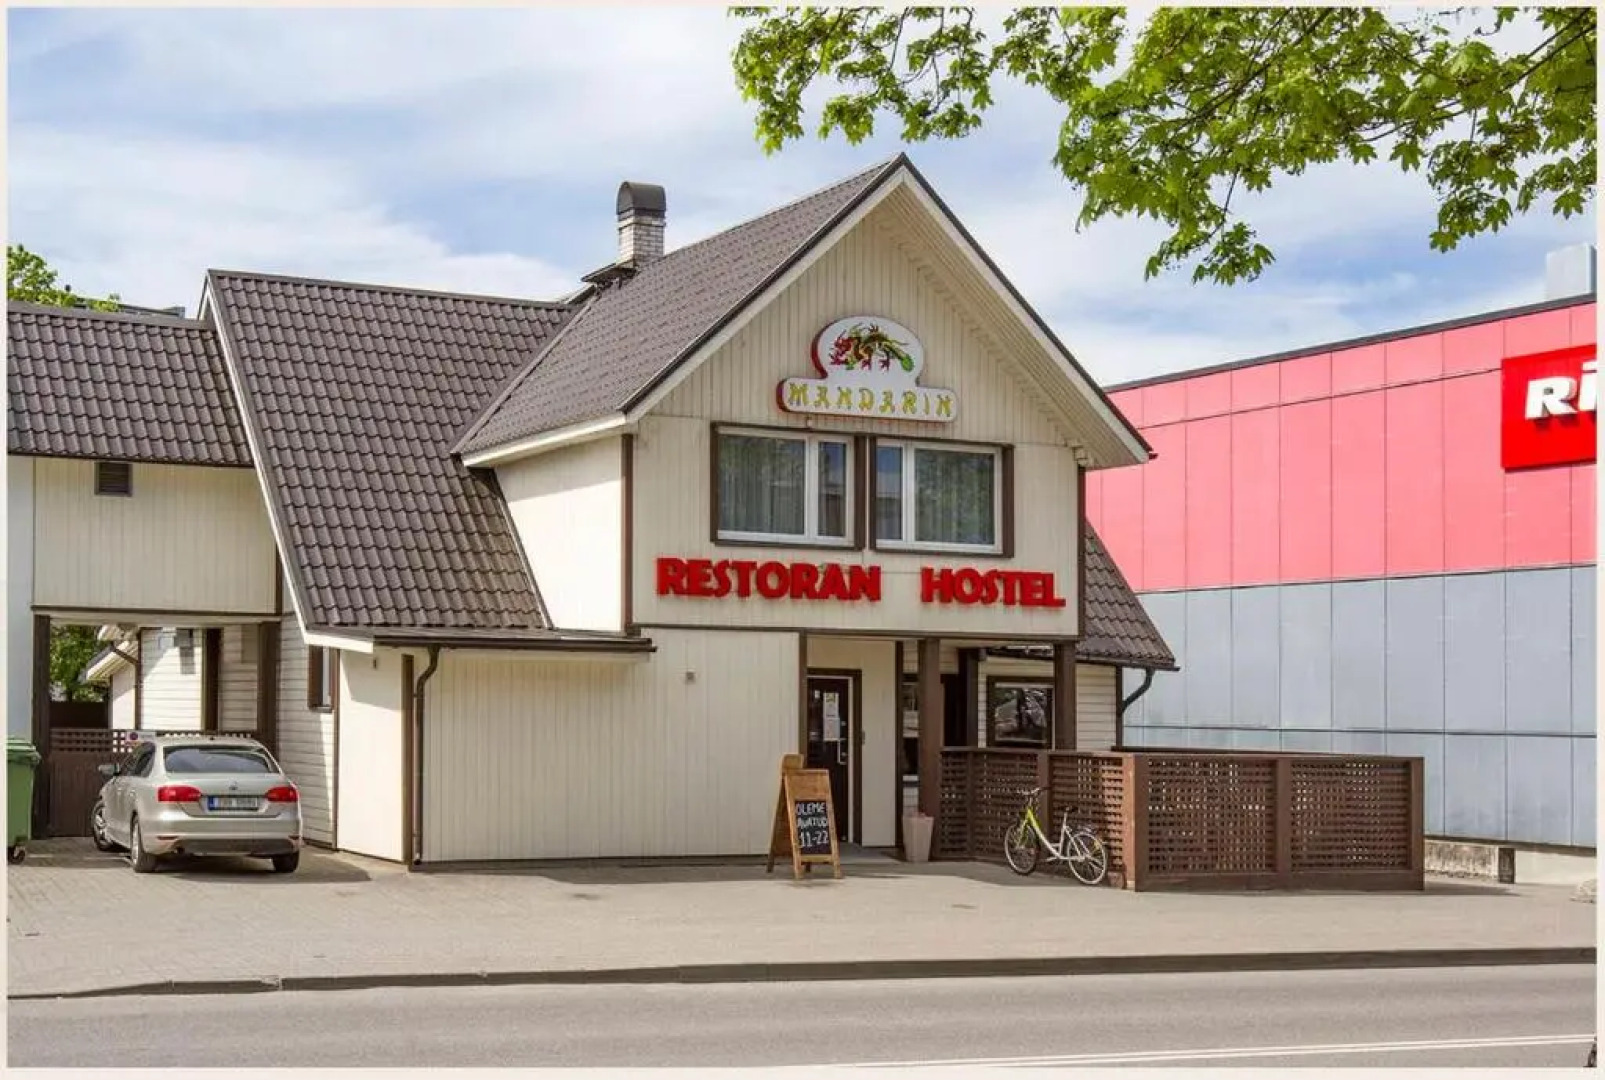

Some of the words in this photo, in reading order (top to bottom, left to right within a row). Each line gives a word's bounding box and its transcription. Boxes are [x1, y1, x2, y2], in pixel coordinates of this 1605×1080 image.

[788, 382, 953, 418] MANDARIN
[657, 557, 881, 602] RESTORAN
[921, 567, 1066, 608] HOSTEL
